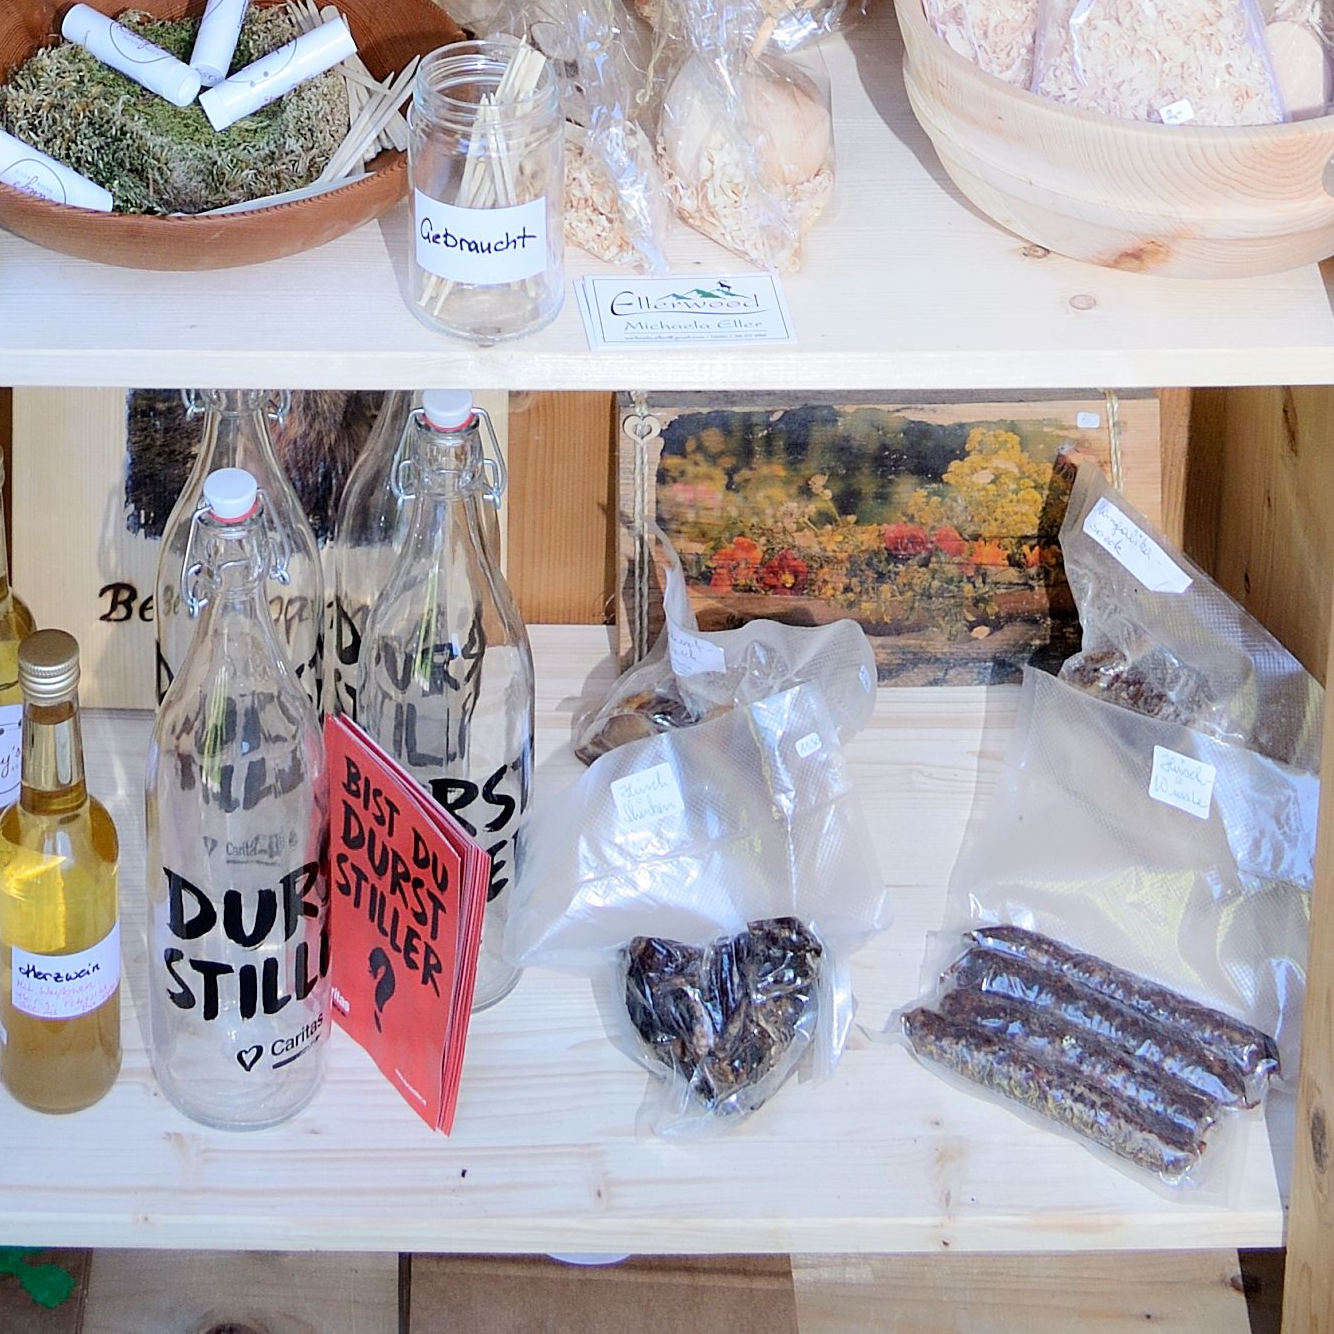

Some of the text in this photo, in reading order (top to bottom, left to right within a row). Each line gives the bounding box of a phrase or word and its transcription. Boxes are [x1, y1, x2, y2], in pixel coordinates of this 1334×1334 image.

[419, 217, 537, 255] Gebraucht
[610, 291, 759, 316] Ellerwood
[624, 319, 762, 331] Michaela Eller
[342, 755, 450, 891] BIST DU
[343, 805, 446, 940] DURST
[335, 853, 442, 995] STILLER
[271, 1012, 324, 1058] Caritas
